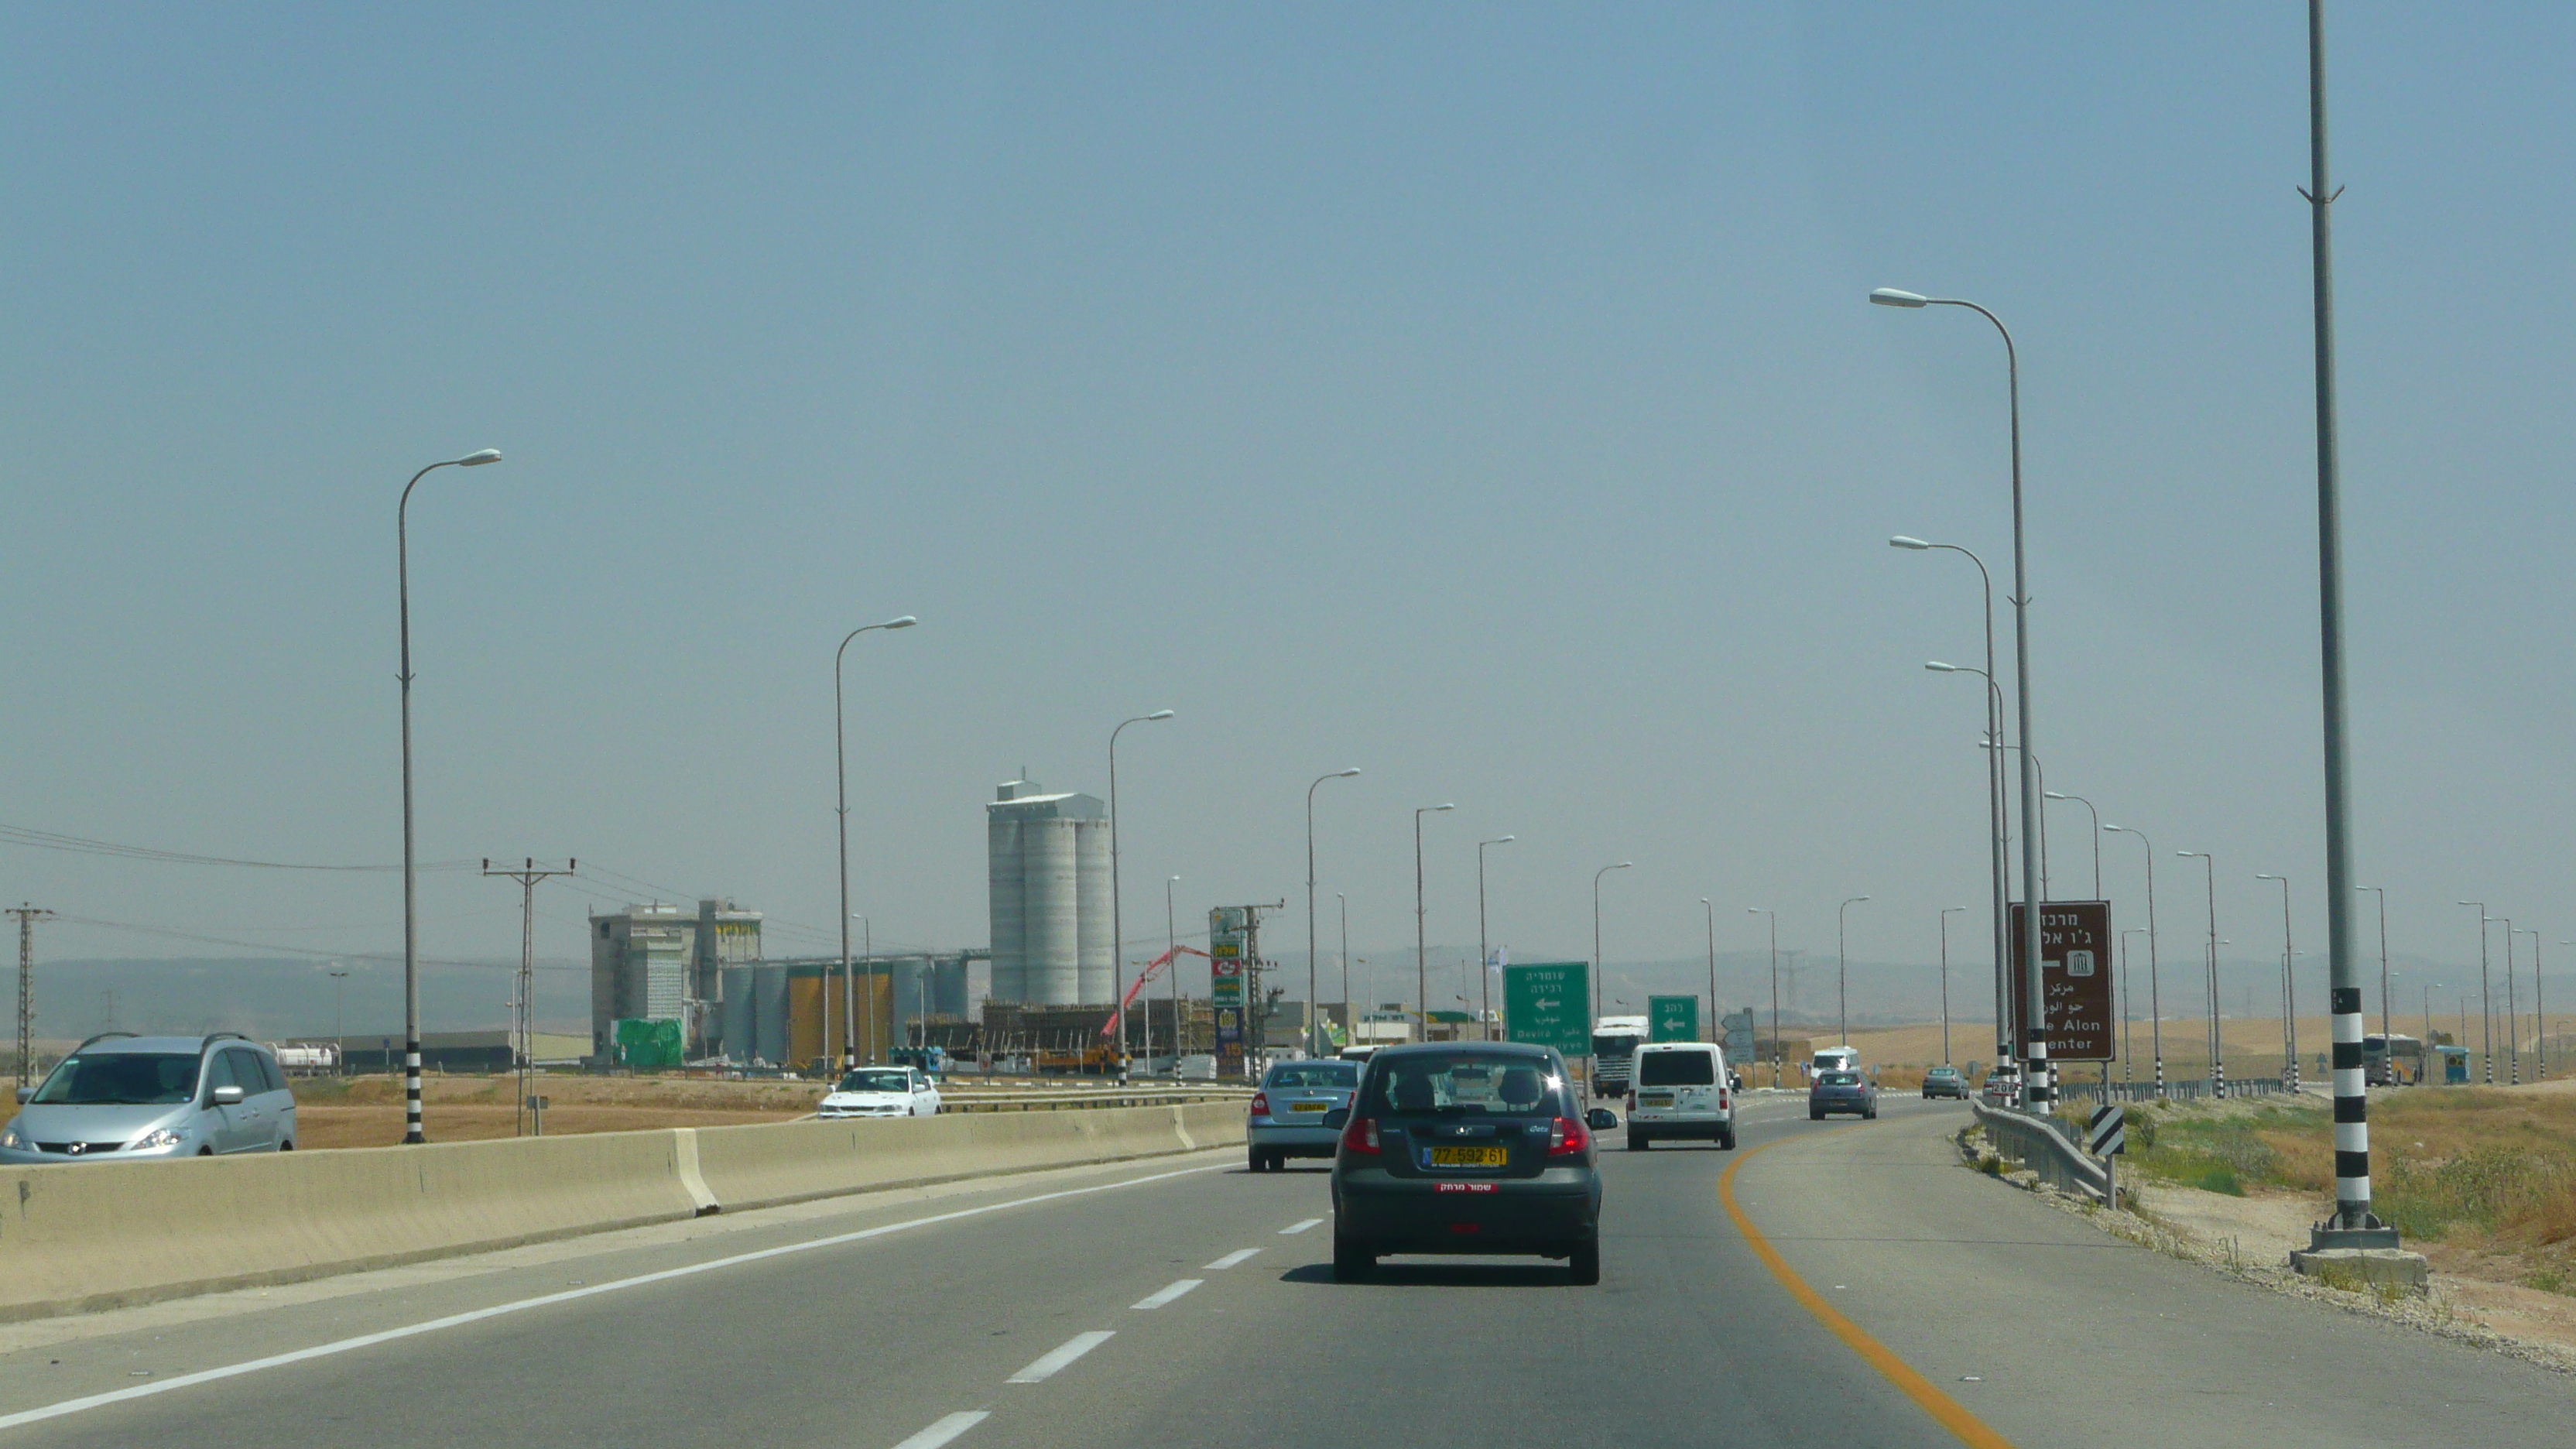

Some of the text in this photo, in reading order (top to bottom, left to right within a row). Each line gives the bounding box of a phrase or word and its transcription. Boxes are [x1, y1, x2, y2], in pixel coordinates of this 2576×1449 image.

[2041, 914, 2078, 926] מרכז
[2042, 931, 2062, 944] אל
[2064, 1019, 2100, 1031] Alon
[2048, 1038, 2092, 1050] enter
